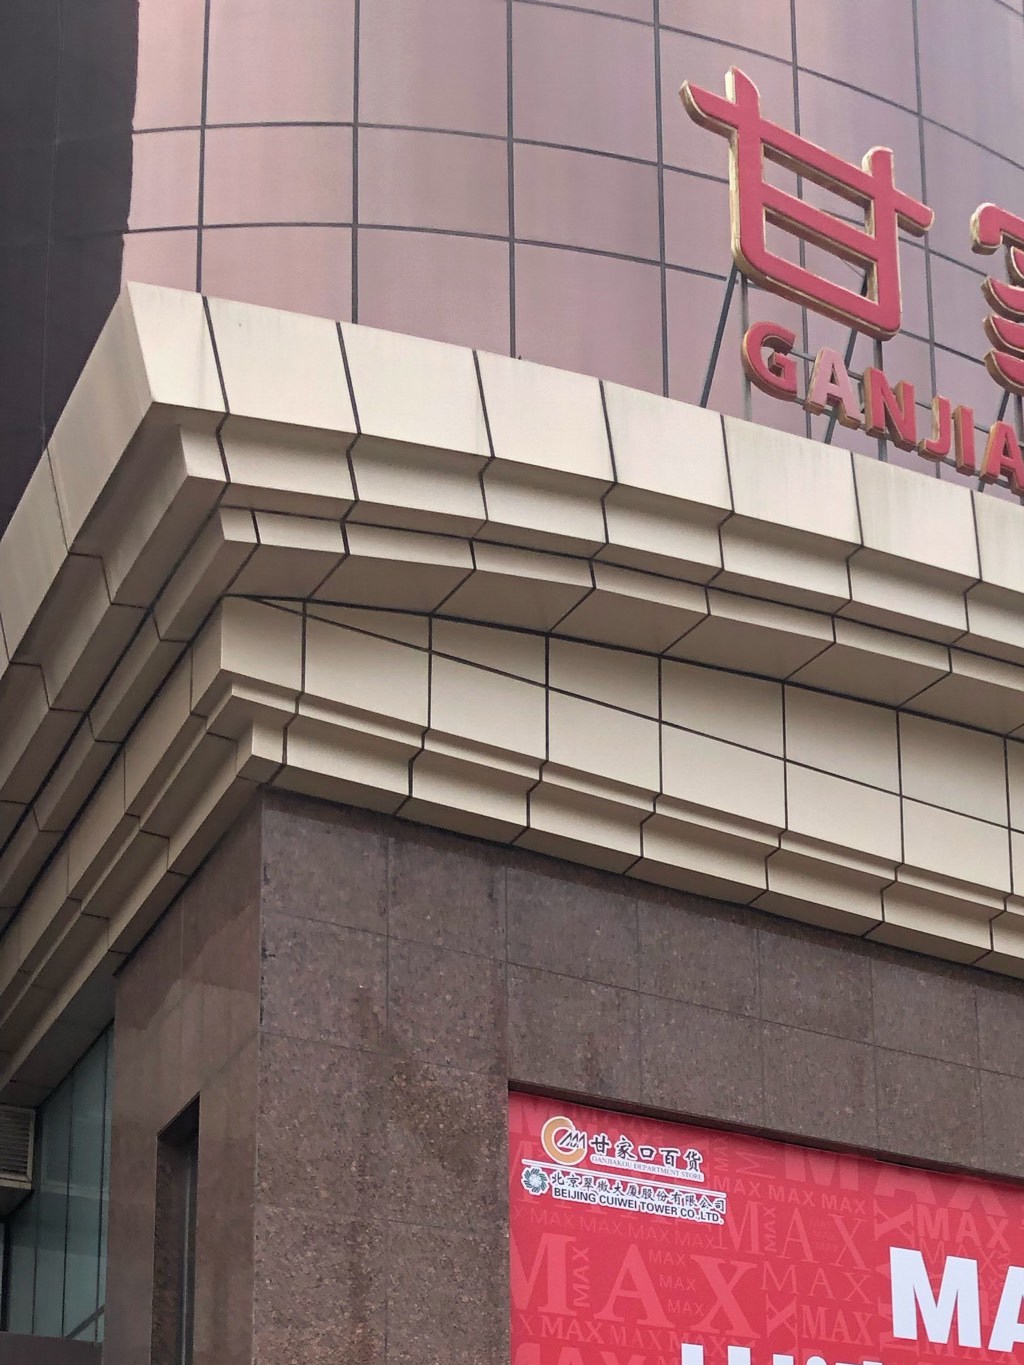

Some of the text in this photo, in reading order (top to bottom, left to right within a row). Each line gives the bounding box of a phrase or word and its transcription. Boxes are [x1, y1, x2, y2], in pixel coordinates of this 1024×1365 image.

[591, 1136, 701, 1172] 甘家口百货
[591, 1155, 703, 1181] GANJIAKOU DEPARTMENT STORE
[552, 1171, 726, 1212] 北京翠微大厦股份有限公司
[554, 1187, 597, 1203] BEIJING
[600, 1194, 637, 1210] CUIWEI
[640, 1201, 678, 1216] TOWER
[713, 1175, 761, 1199] MAX
[768, 1184, 815, 1207] MAX
[821, 1193, 867, 1215] MAX
[530, 1207, 576, 1227] MAX
[580, 1216, 621, 1234] MAX
[628, 1224, 670, 1244] MAX
[917, 1204, 1010, 1250] MAX
[761, 1261, 874, 1304] MAX
[541, 1316, 605, 1344] MAX
[610, 1324, 663, 1352] MAX
[801, 1304, 874, 1346] MAX
